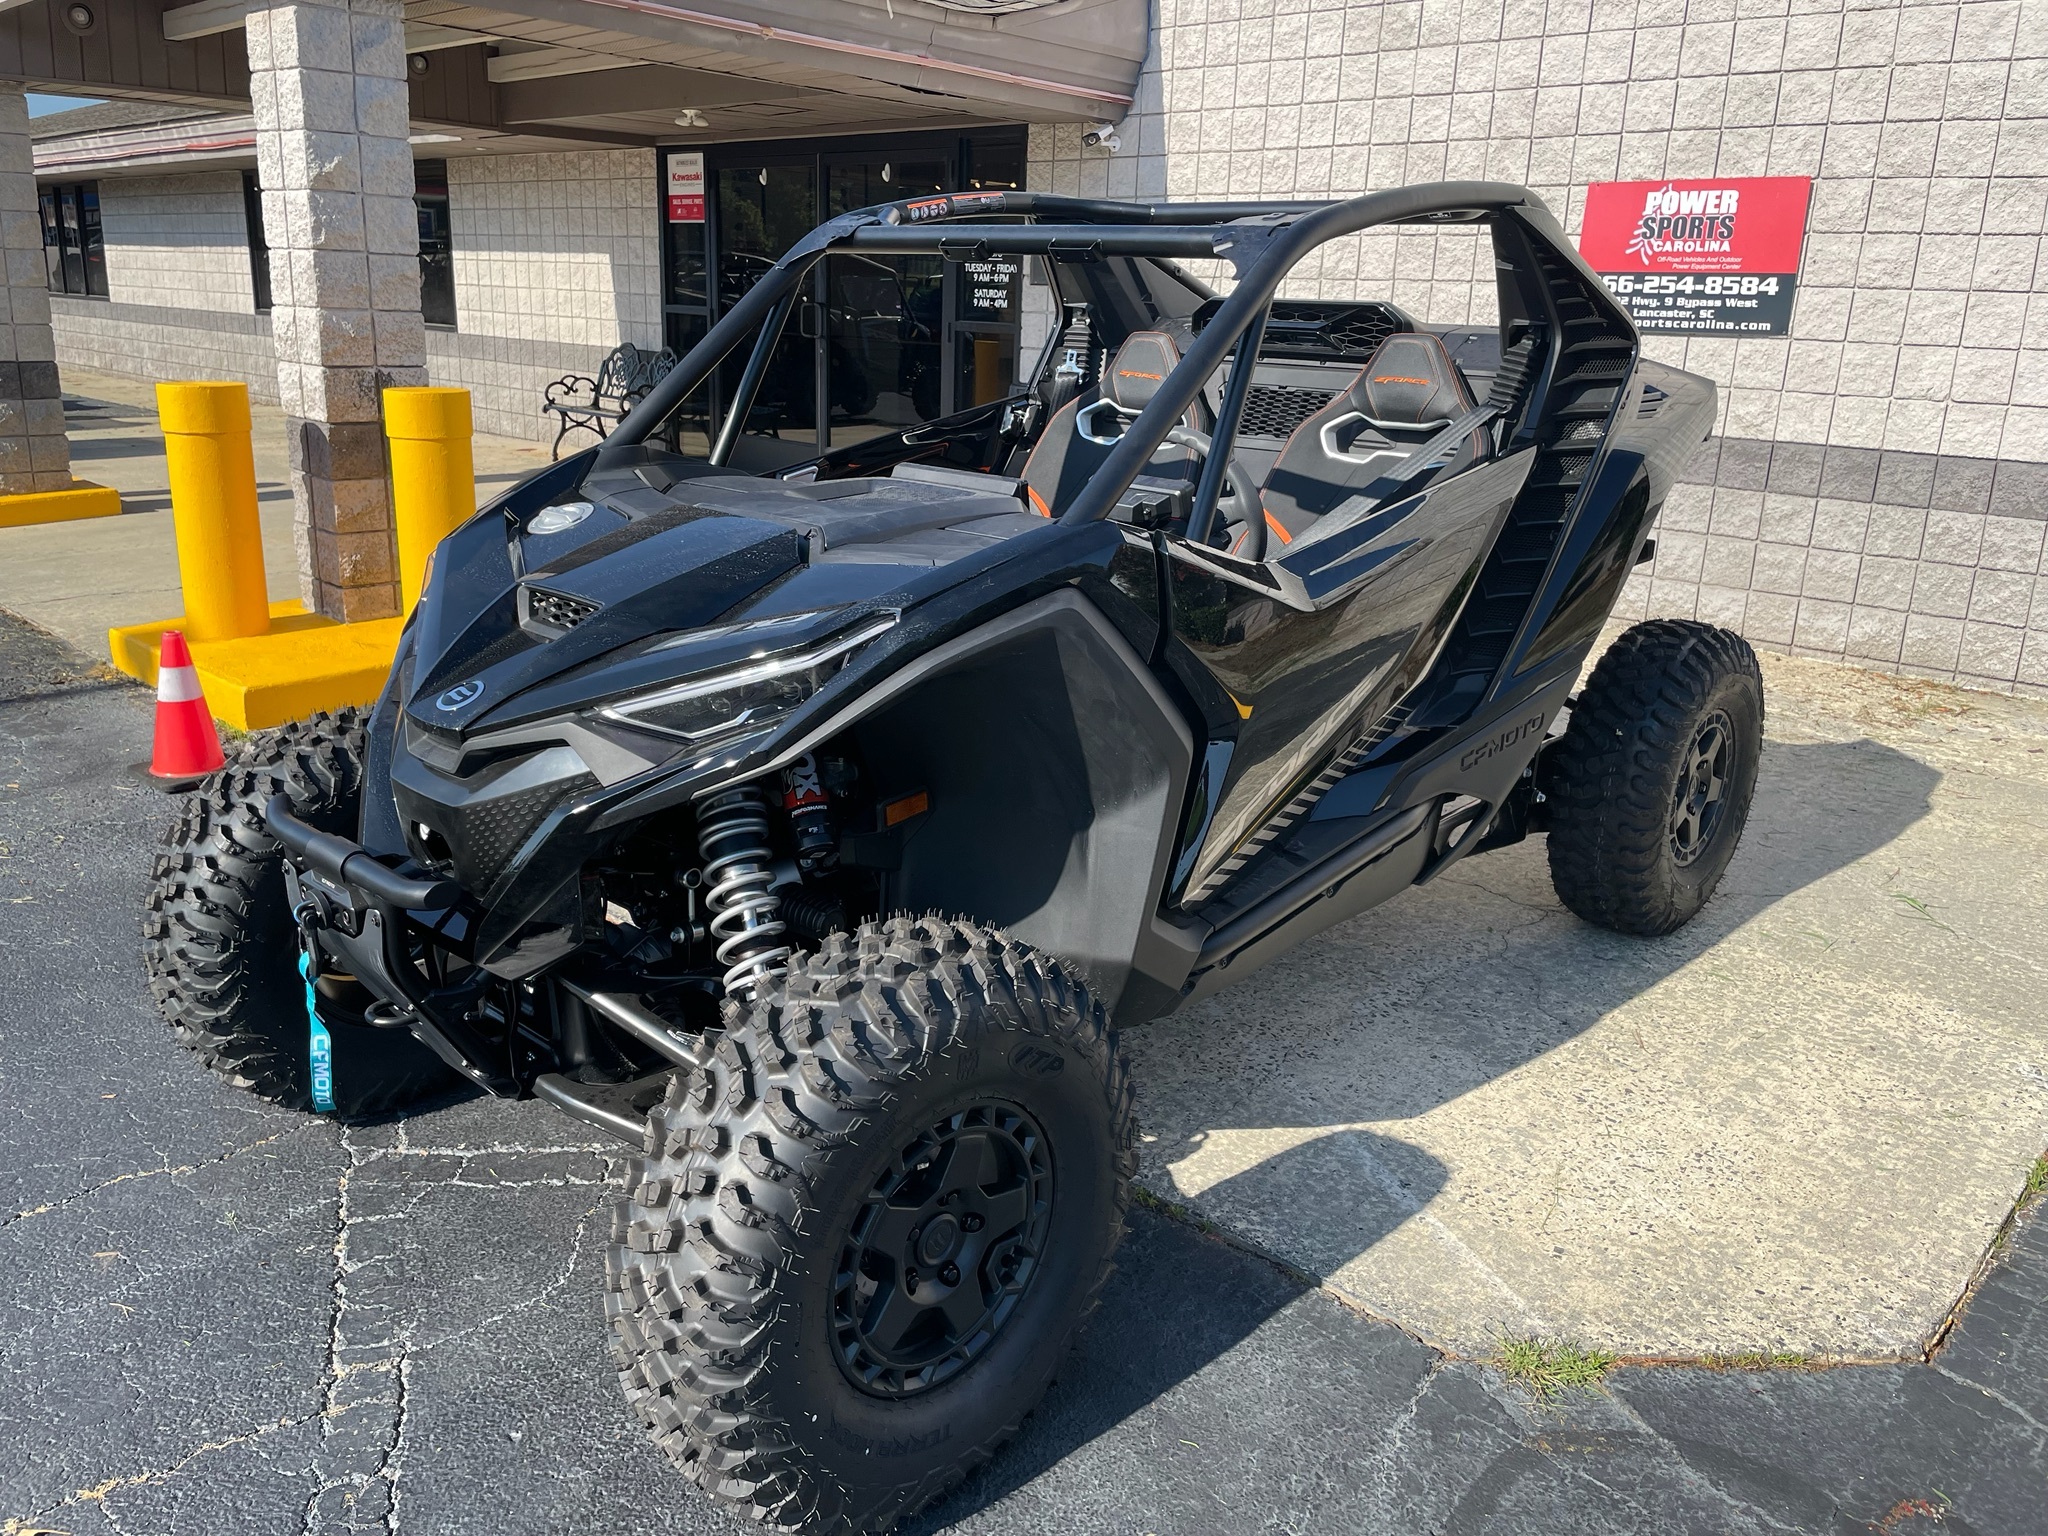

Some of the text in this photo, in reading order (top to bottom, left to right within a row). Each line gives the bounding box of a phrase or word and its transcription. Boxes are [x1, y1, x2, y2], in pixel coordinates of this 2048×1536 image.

[672, 172, 702, 181] Kawasaki
[1642, 190, 1739, 215] POWER
[1641, 214, 1735, 240] SPORTS
[1652, 240, 1731, 253] CAROLINA
[965, 263, 992, 272] TUESDAY
[1691, 263, 1721, 271] Equipment
[973, 273, 978, 282] 9
[978, 273, 990, 282] AM
[1598, 275, 1779, 296] 66-254-8584
[974, 289, 1007, 298] SATURDAY
[973, 299, 978, 307] 9
[978, 299, 990, 308] AM
[1632, 296, 1660, 308] Hwy.
[1664, 297, 1673, 306] 9
[1676, 297, 1722, 309] Bypass
[1725, 298, 1758, 308] West
[1633, 308, 1715, 320] Lancaster, SC
[1459, 711, 1545, 773] CFMOTO
[312, 1033, 331, 1105] CFMOTO
